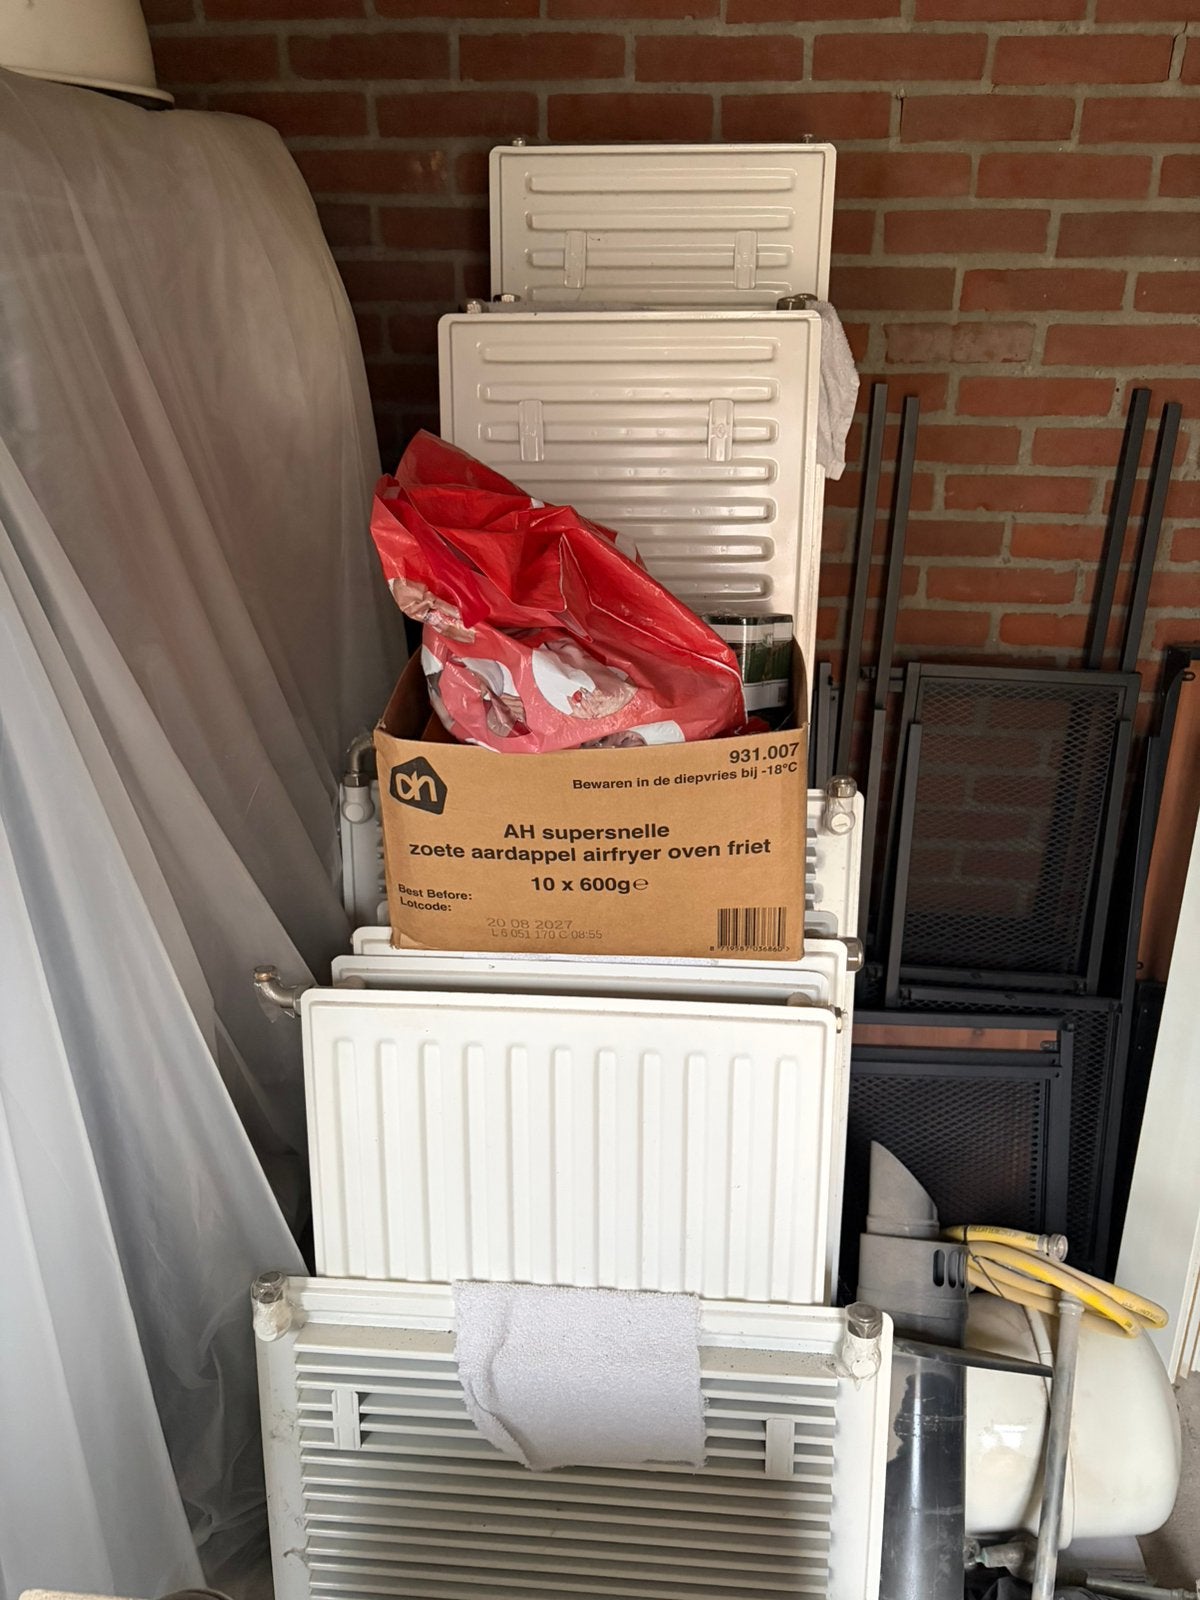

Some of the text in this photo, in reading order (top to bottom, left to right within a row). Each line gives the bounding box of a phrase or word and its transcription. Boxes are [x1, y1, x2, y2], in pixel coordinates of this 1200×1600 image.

[729, 742, 800, 764] 931.007
[572, 761, 798, 790] Bewaren in de diepvries bij -18°C
[503, 823, 670, 843] AH supersnelle
[409, 838, 772, 865] zoete aardappel airfryer oven friet
[398, 883, 473, 901] Best Before:
[531, 876, 555, 891] 10
[561, 880, 574, 892] x
[399, 896, 452, 912] Lotcode:
[486, 917, 574, 930] 20 08 2027
[510, 928, 531, 939] 051
[535, 929, 556, 940] 170
